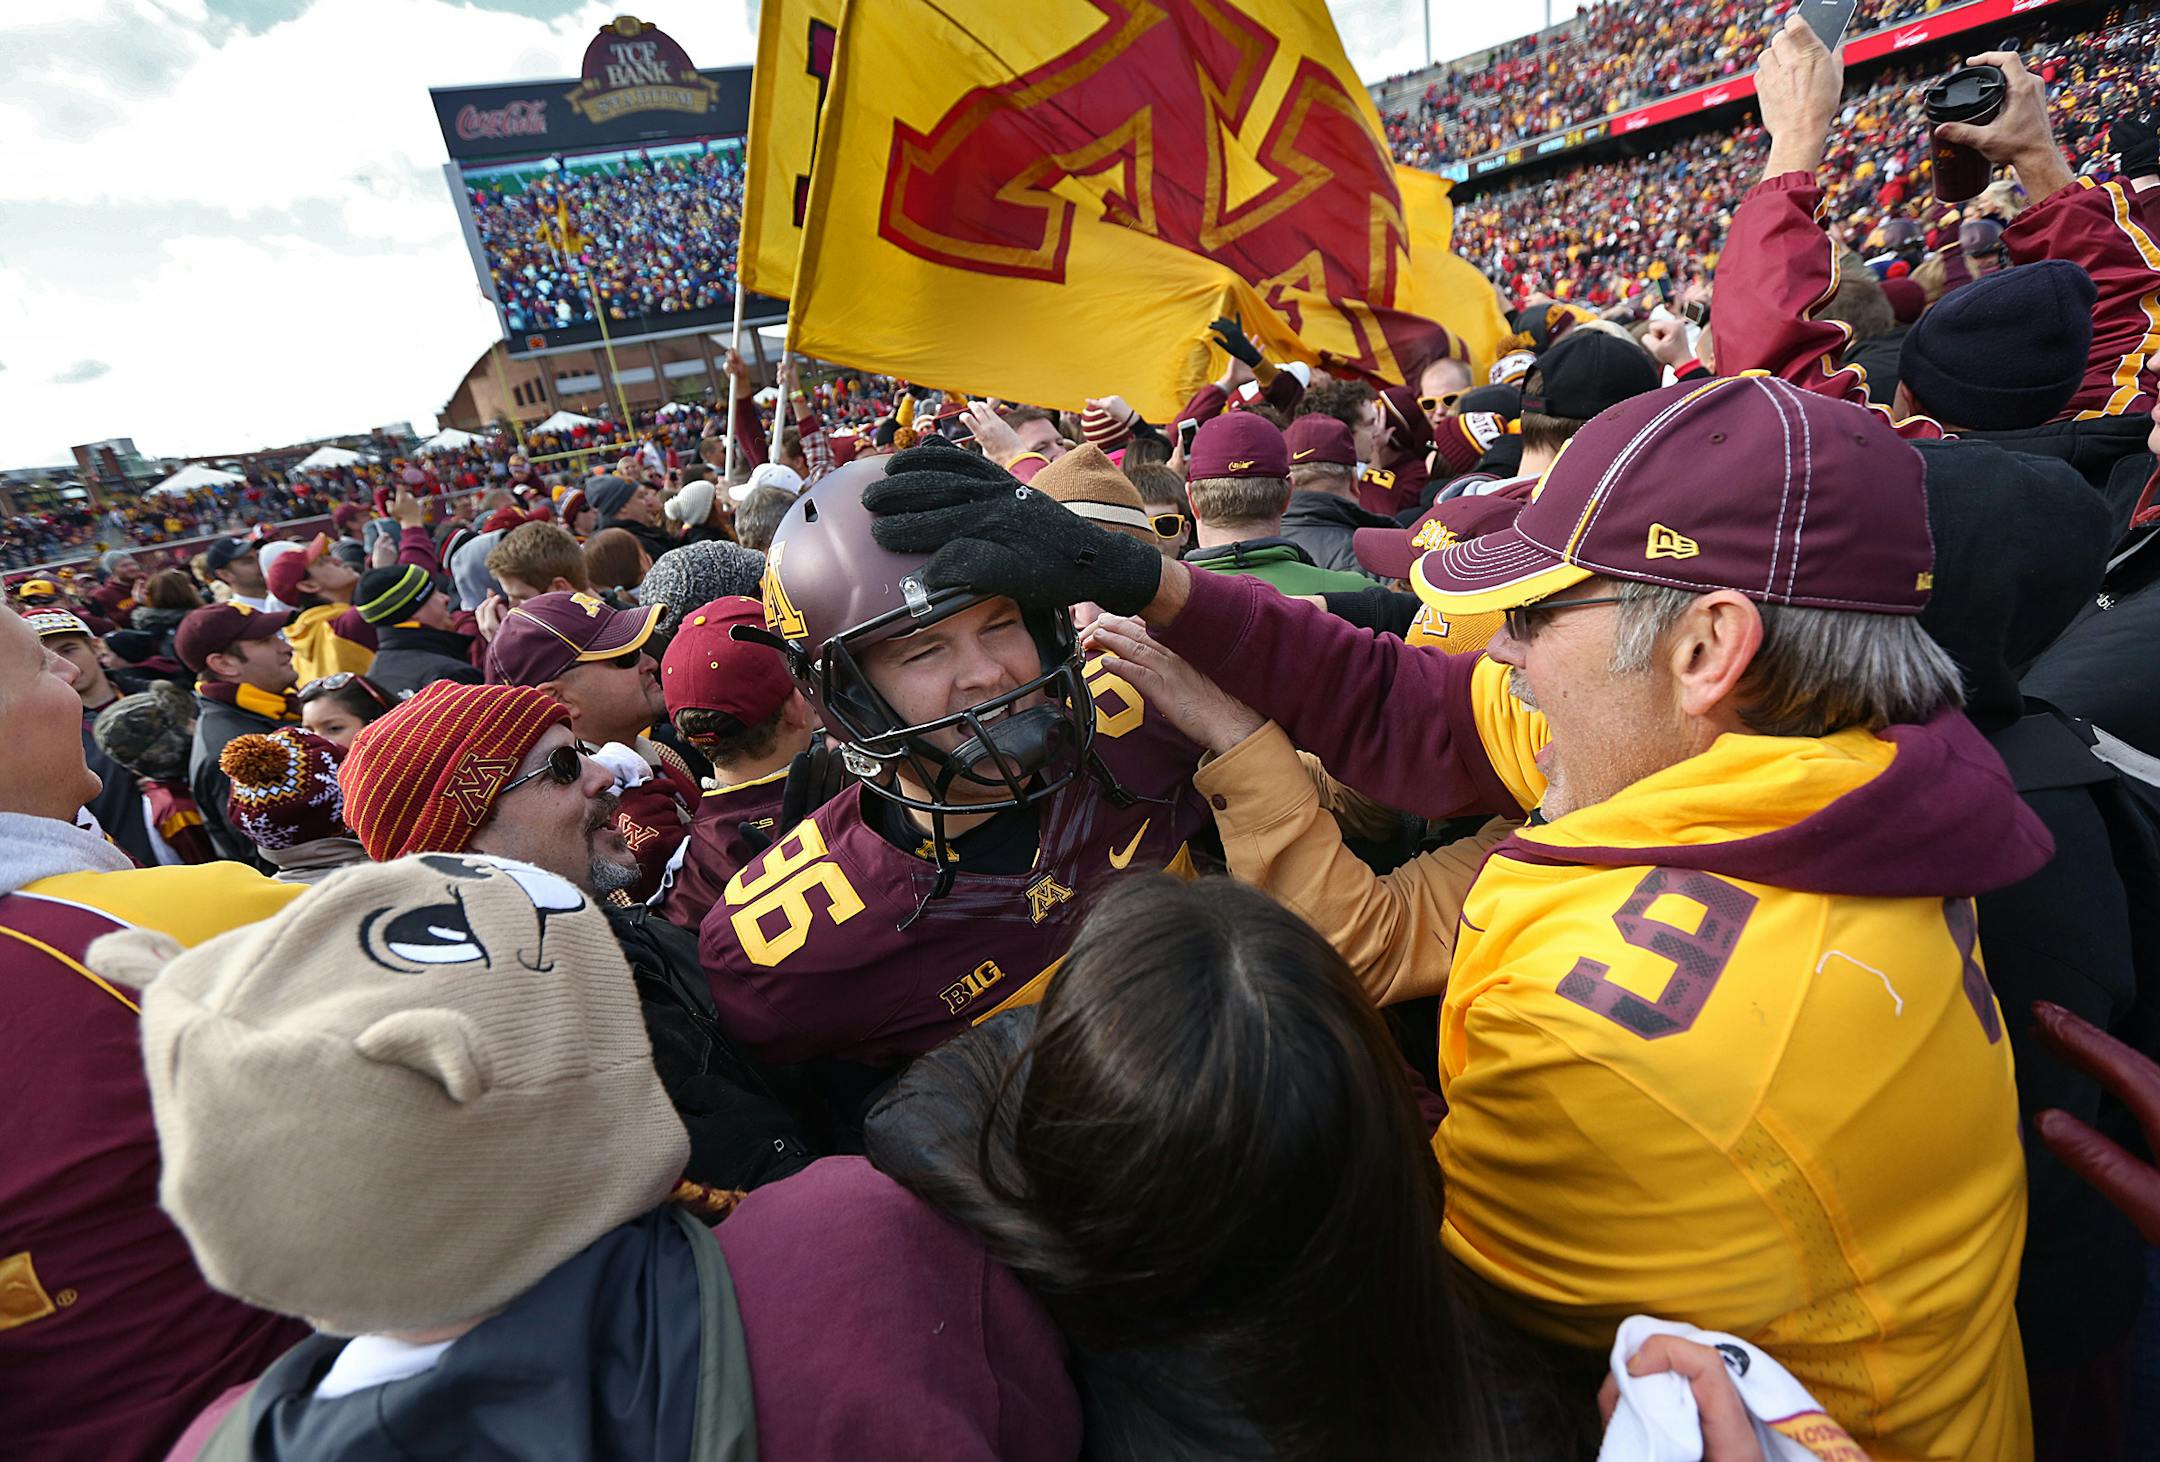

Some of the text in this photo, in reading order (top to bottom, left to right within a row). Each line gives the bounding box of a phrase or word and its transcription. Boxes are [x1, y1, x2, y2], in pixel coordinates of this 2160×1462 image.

[604, 62, 673, 89] BANK
[609, 41, 658, 66] TCF
[455, 99, 548, 141] Coca-Cola
[443, 752, 519, 827] M
[723, 818, 867, 968] 96
[1024, 873, 1075, 926] M
